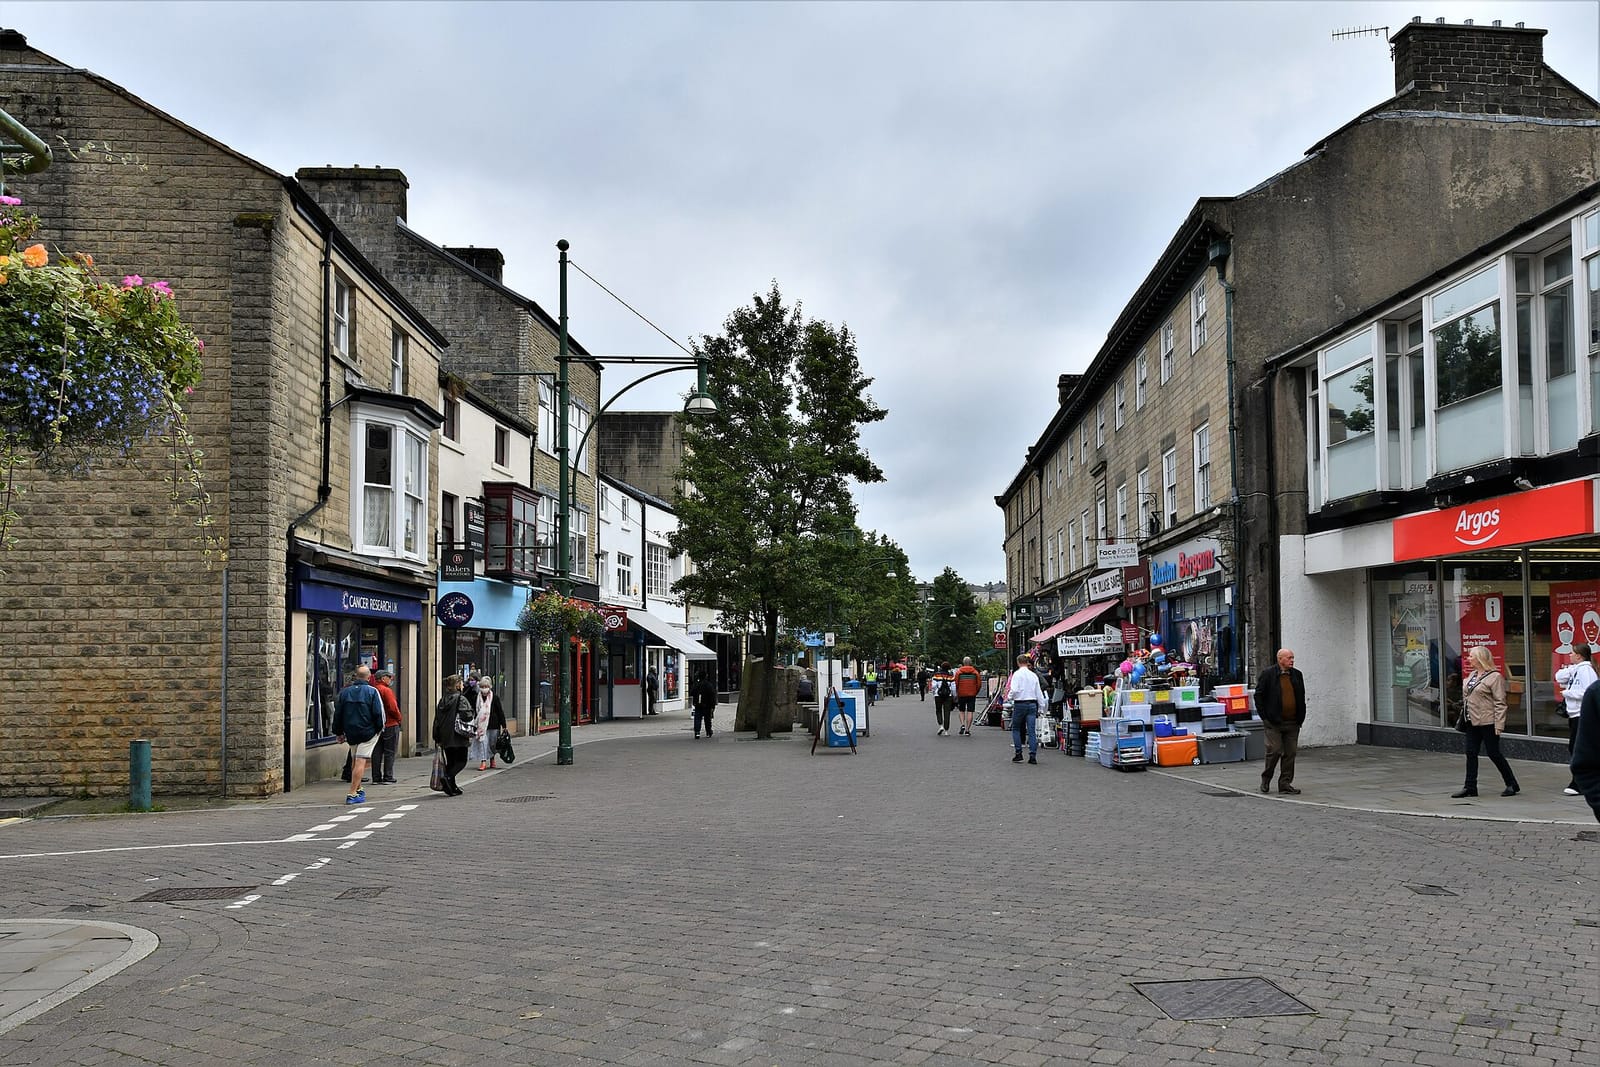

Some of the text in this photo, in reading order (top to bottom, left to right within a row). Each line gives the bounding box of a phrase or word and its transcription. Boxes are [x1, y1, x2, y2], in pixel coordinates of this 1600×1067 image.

[1455, 508, 1500, 535] Argos
[1152, 549, 1215, 585] Buxton Bargains
[349, 595, 369, 609] CANCER
[370, 598, 391, 612] RESEARCH
[391, 602, 399, 613] UK
[1075, 635, 1101, 644] Village
